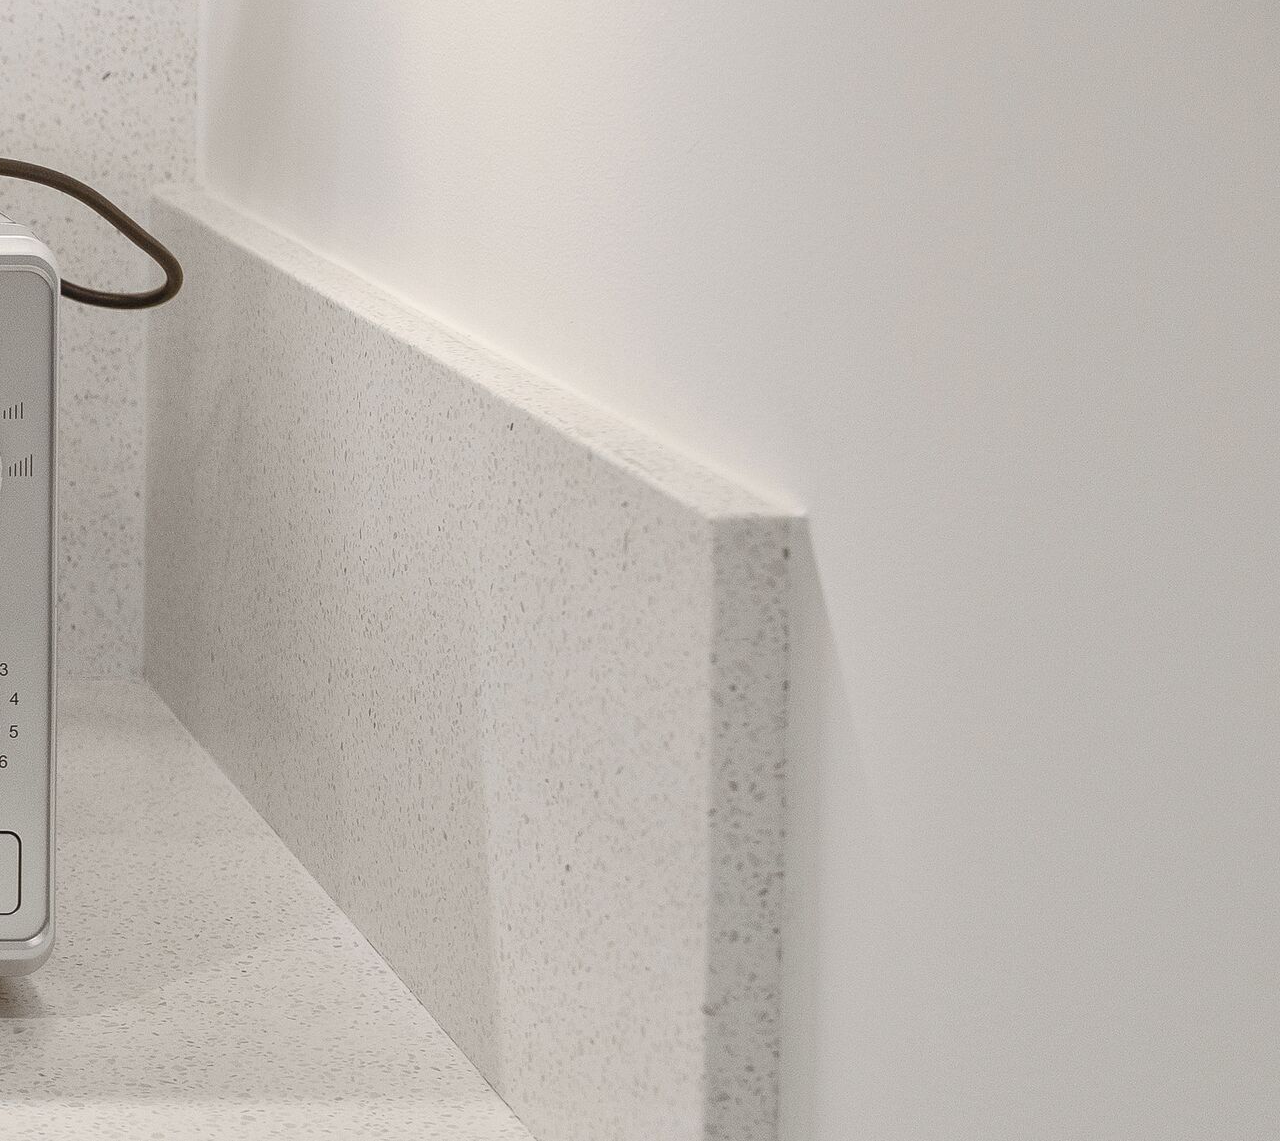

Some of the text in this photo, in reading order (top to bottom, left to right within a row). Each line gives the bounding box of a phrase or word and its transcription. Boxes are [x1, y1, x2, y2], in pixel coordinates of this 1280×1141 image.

[0, 663, 9, 677] 3
[9, 692, 20, 706] 4
[8, 725, 19, 739] 5
